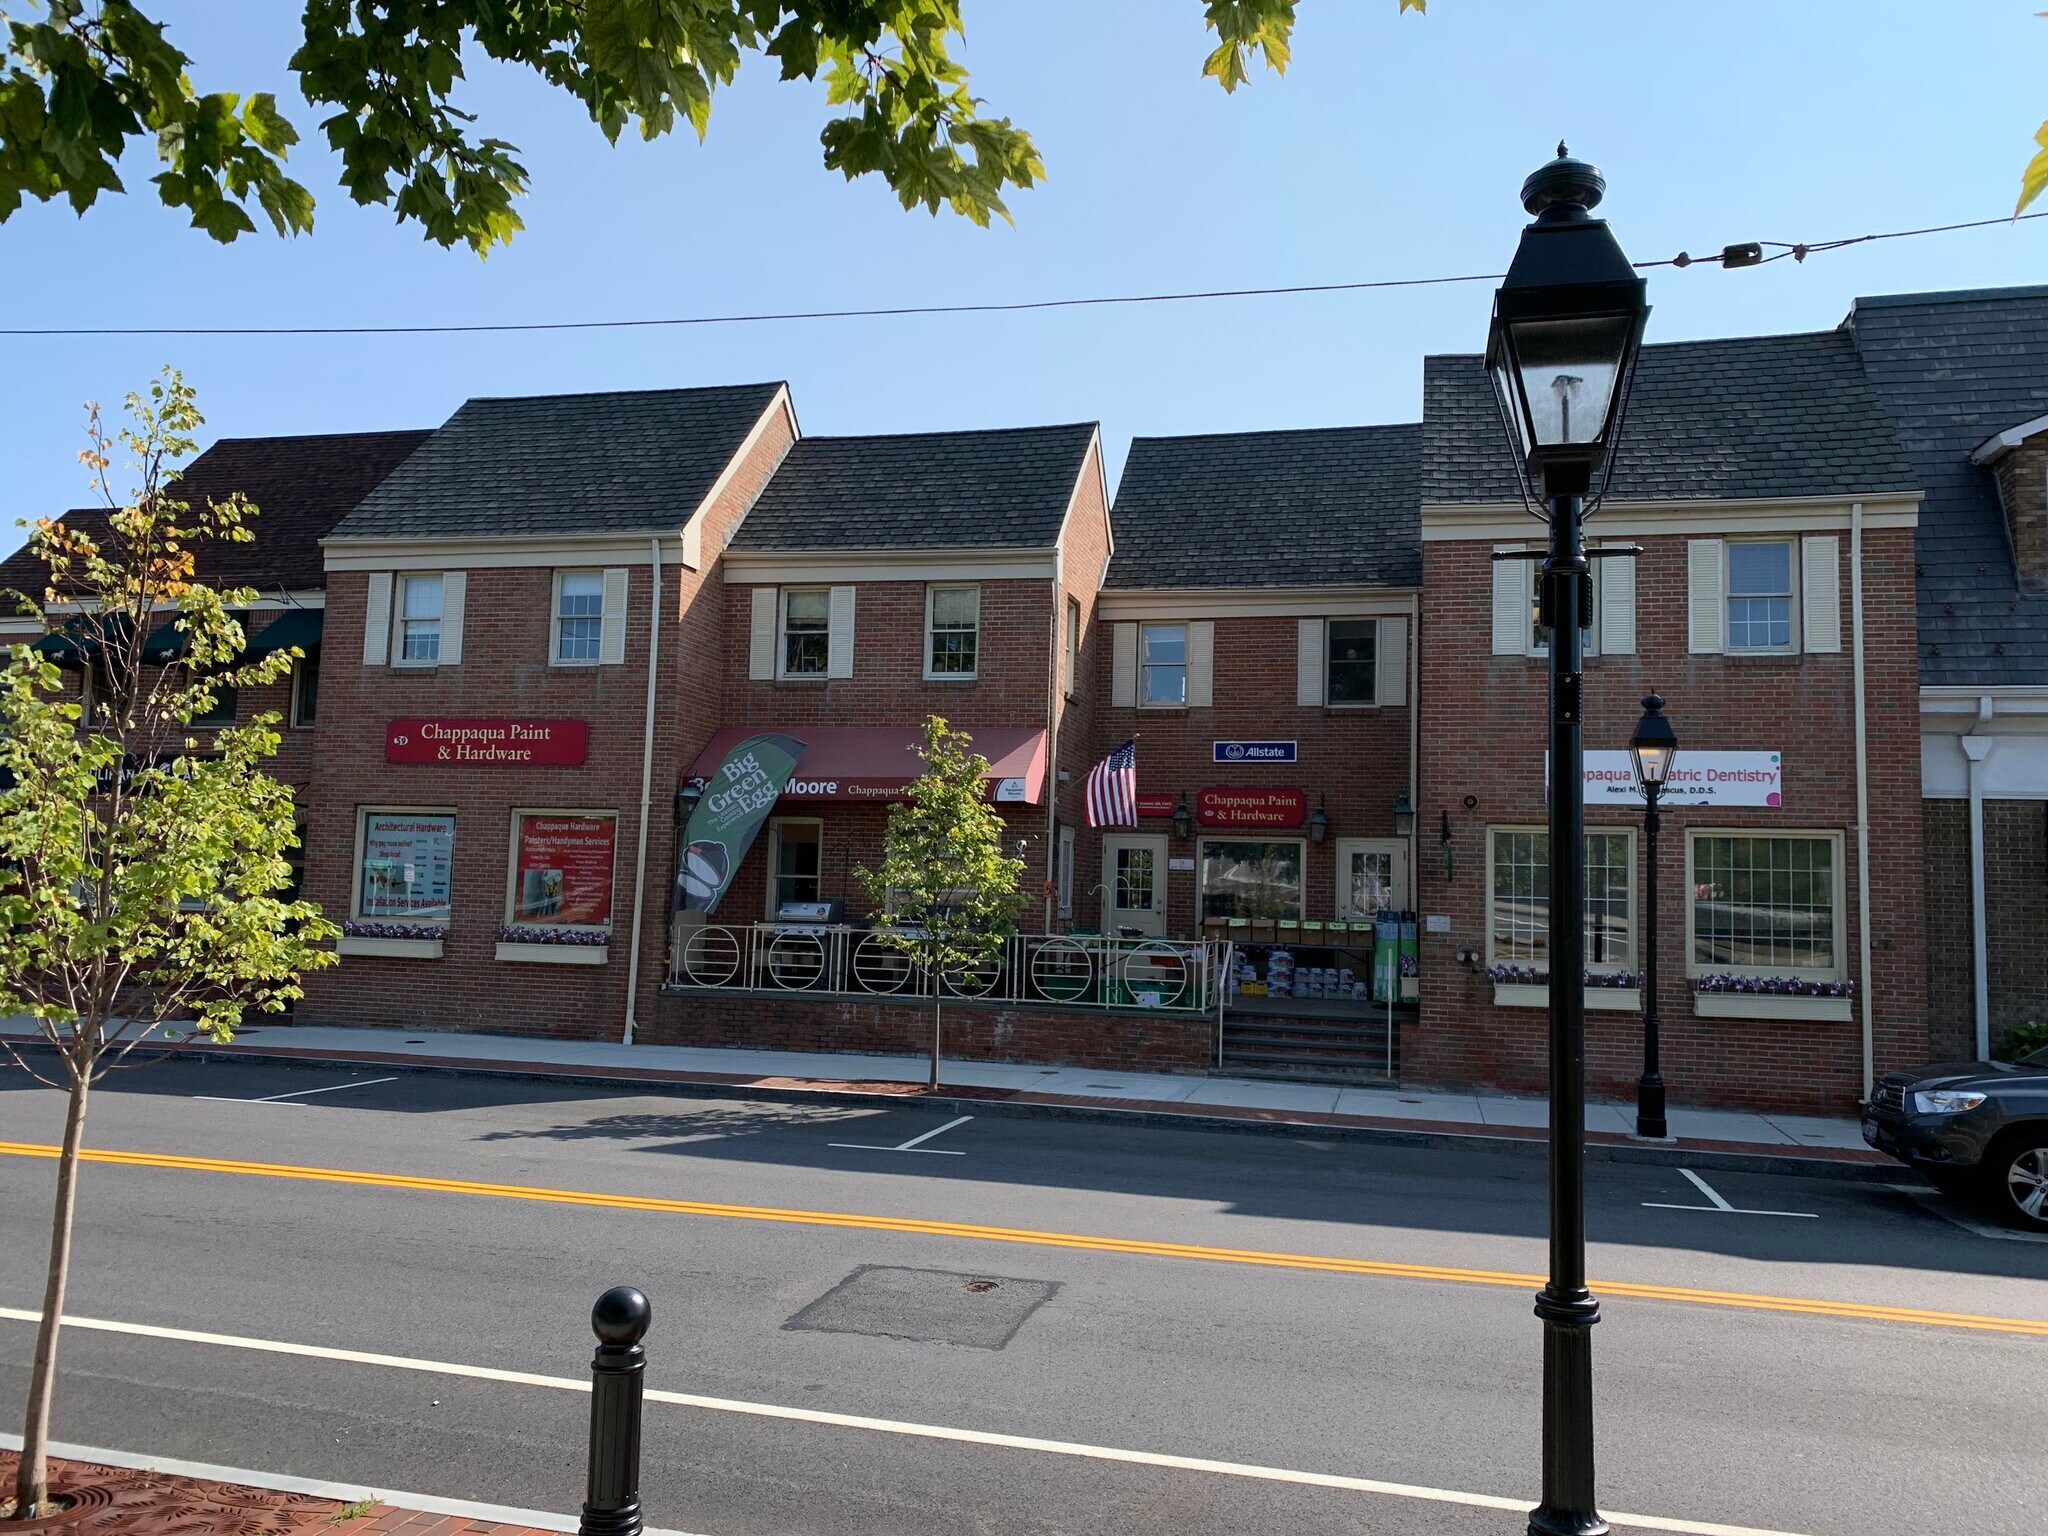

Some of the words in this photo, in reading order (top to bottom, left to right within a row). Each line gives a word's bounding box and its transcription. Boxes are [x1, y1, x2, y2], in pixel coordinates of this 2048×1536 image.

[421, 723, 506, 745] Chappaqua
[510, 724, 551, 741] Paint
[437, 745, 452, 760] &
[456, 744, 531, 761] Hardware
[1245, 747, 1285, 757] Allstate
[721, 751, 760, 783] Big
[1707, 768, 1777, 785] Dentistry
[707, 768, 769, 813] Green
[781, 777, 838, 795] Moore
[847, 784, 900, 797] Chappaqua
[1689, 786, 1717, 795] D.D.S.
[737, 780, 778, 815] Egg
[1204, 794, 1265, 808] Chappaqua
[1268, 795, 1297, 806] Paint
[1217, 810, 1227, 820] &
[1231, 810, 1284, 821] Hardware
[374, 821, 415, 832] Architectural
[416, 821, 447, 832] Hardware
[536, 821, 569, 832] Chappaqua
[570, 821, 600, 831] Hardware
[584, 837, 610, 846] Services
